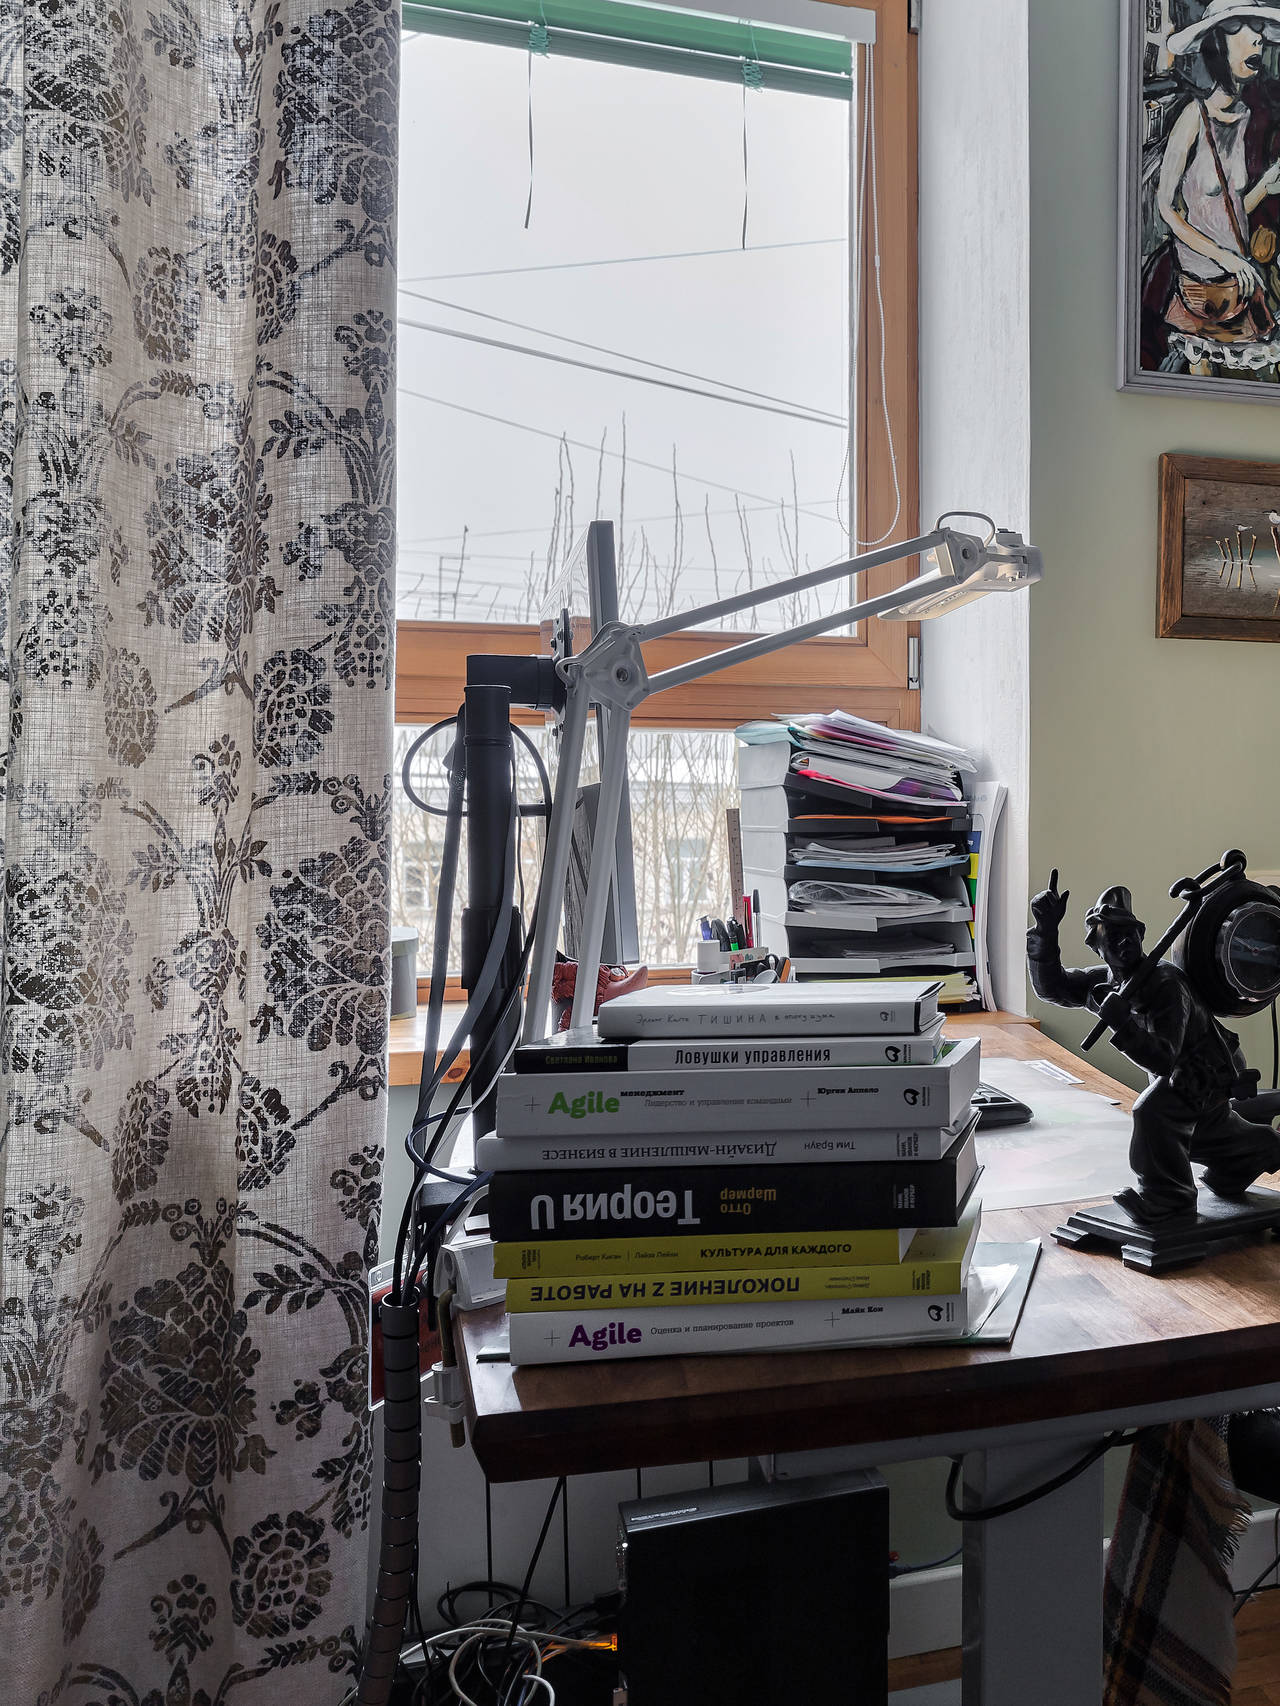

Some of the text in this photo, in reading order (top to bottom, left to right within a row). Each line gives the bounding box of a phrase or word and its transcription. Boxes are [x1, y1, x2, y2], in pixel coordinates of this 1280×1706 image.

[697, 1014, 767, 1025] ТИШИНА
[675, 1049, 831, 1065] Ловушки управления
[620, 1089, 686, 1098] менеджмент
[817, 1087, 846, 1096] Юрген
[548, 1091, 620, 1119] Agile
[804, 1140, 856, 1151] Тим Браун
[541, 1149, 605, 1161] БИЗНЕСЕ
[719, 1187, 777, 1202] Шармер
[530, 1183, 701, 1230] Теория U
[719, 1202, 752, 1215] Отто
[700, 1243, 852, 1258] КУЛЬТУРА ДЛЯ КАЖДОГО
[530, 1277, 800, 1302] ПОКОЛЕНИЕ Z НА РАБОТЕ
[841, 1307, 865, 1315] Майк
[693, 1322, 753, 1332] планирование
[755, 1319, 794, 1329] проектов
[568, 1322, 642, 1351] Agile
